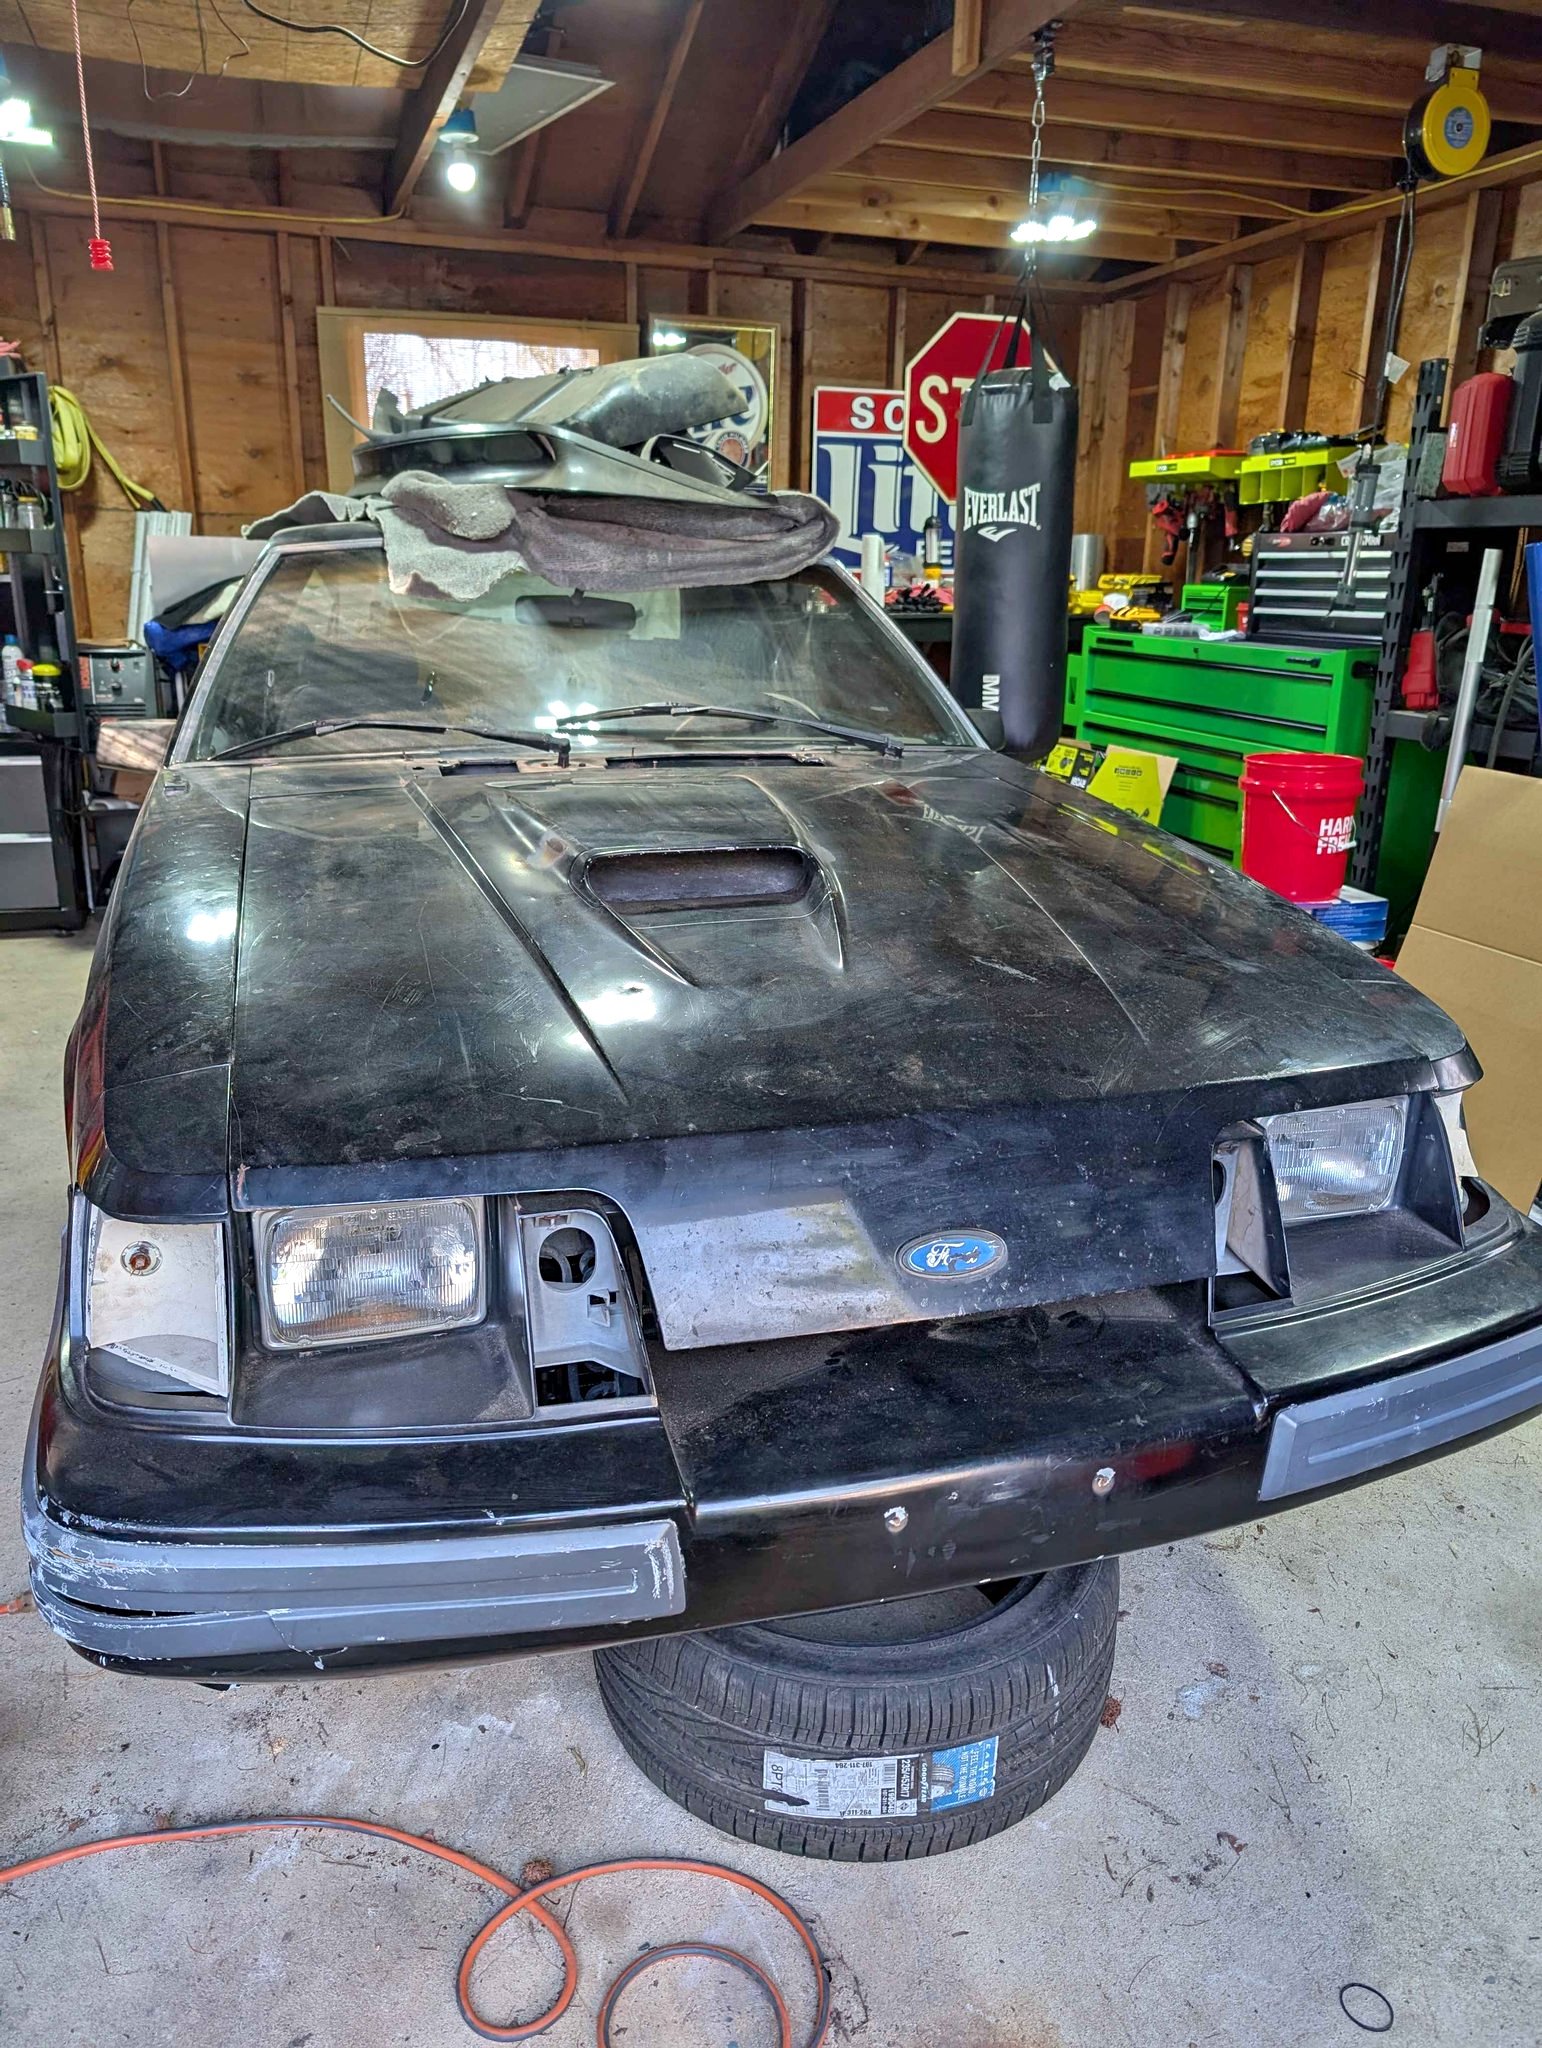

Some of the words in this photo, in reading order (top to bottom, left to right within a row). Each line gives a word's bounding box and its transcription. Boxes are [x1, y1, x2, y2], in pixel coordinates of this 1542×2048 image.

[915, 375, 976, 443] ST
[963, 483, 1041, 531] EVERLAST
[960, 1751, 969, 1763] NOT
[960, 1763, 968, 1775] THE
[970, 1750, 980, 1765] FEEL
[900, 1759, 911, 1797] 235/45ZR17
[921, 1763, 929, 1803] GOODYEAR
[969, 1766, 978, 1777] THE
